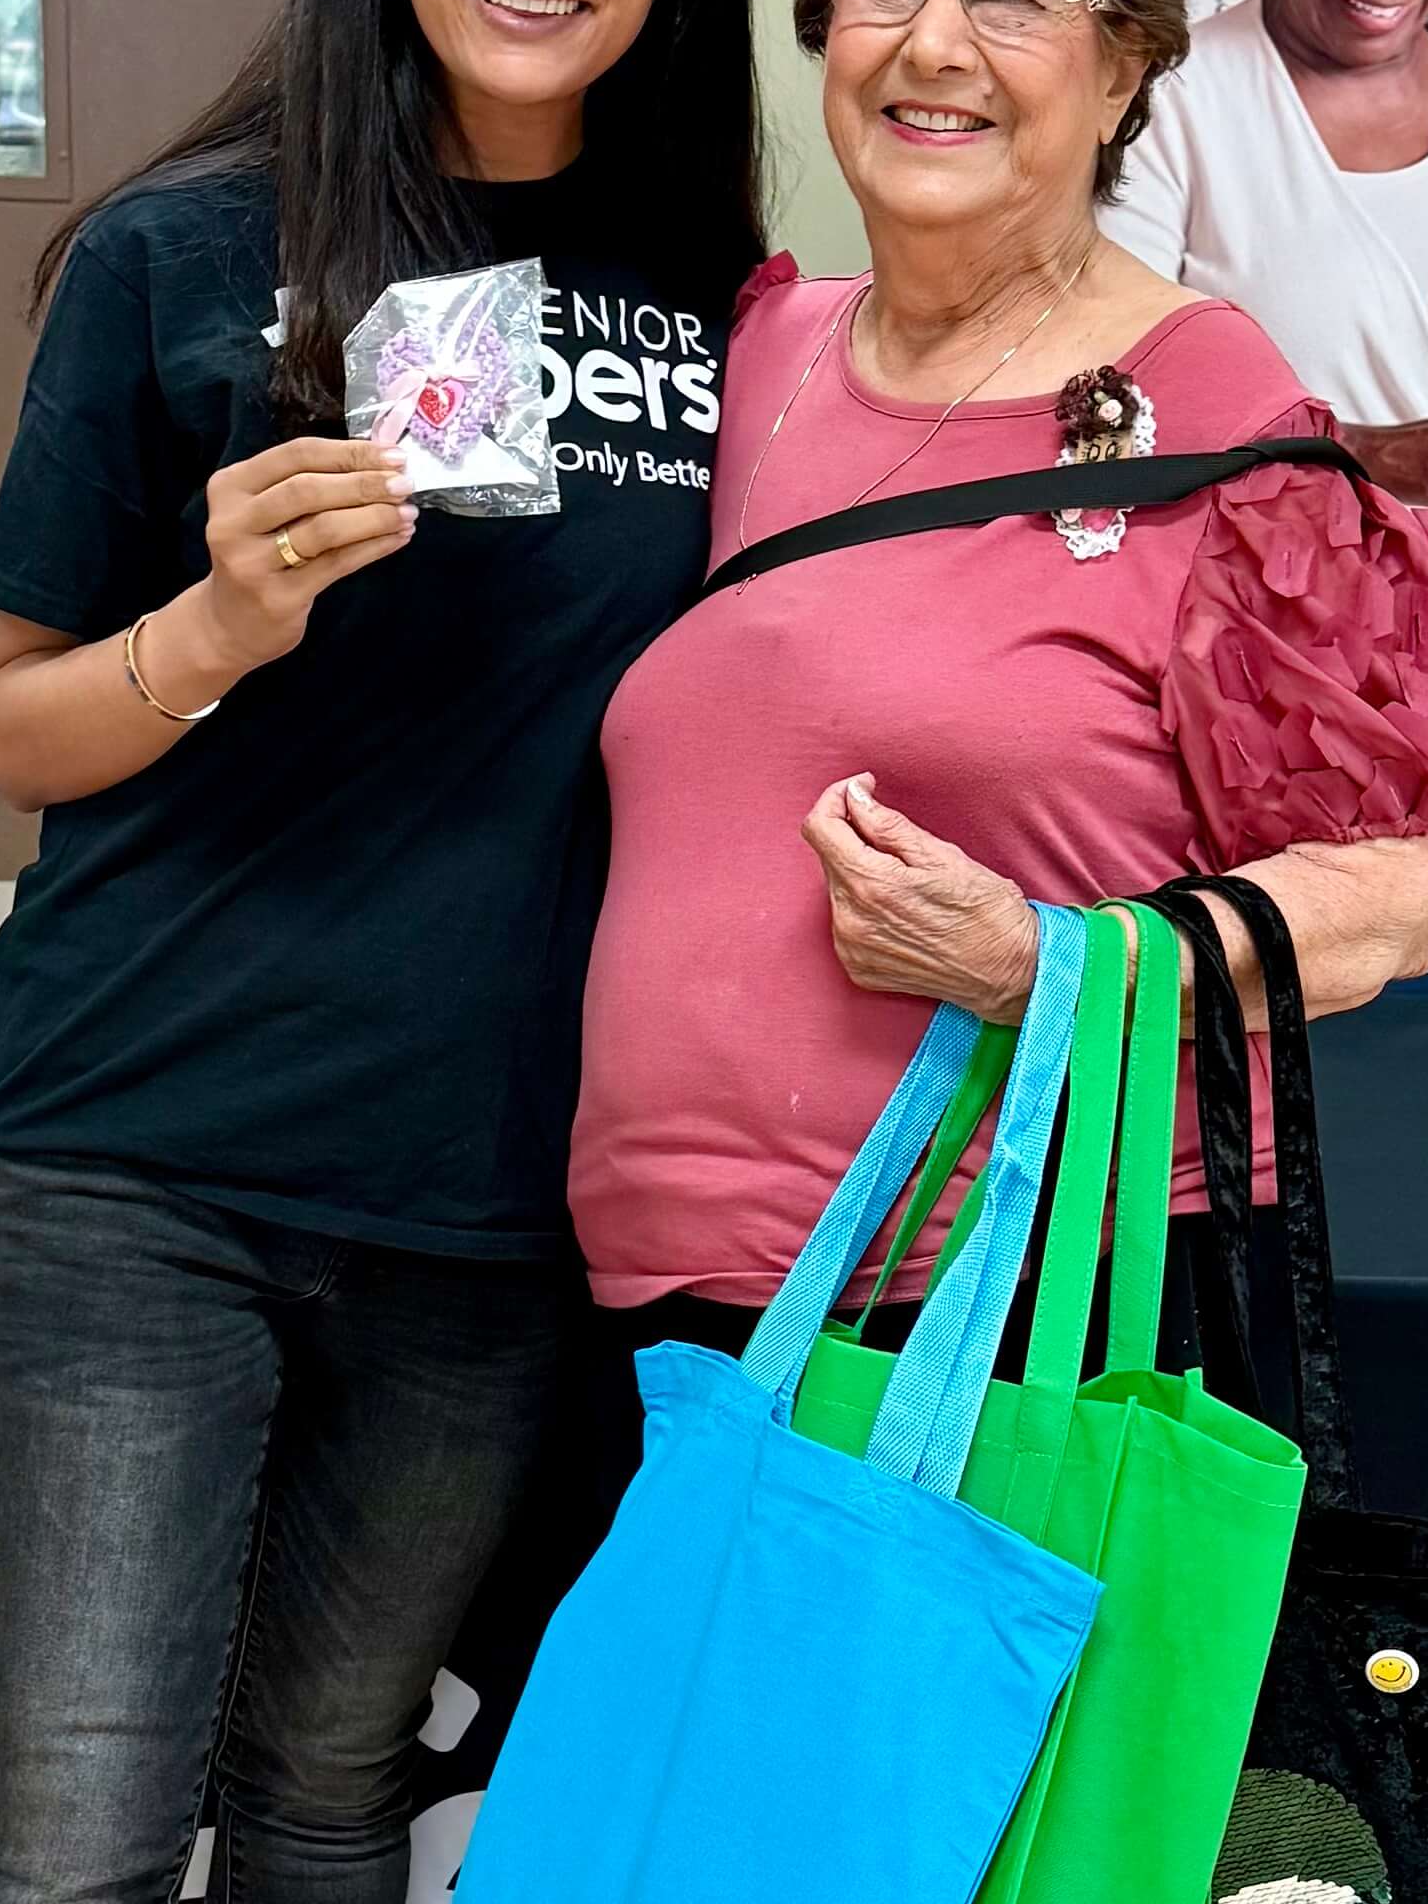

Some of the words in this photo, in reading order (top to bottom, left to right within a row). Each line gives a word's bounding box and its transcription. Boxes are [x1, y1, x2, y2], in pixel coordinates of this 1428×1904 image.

[540, 287, 711, 356] ENIOR
[550, 442, 629, 487] Only
[636, 450, 711, 491] Bette
